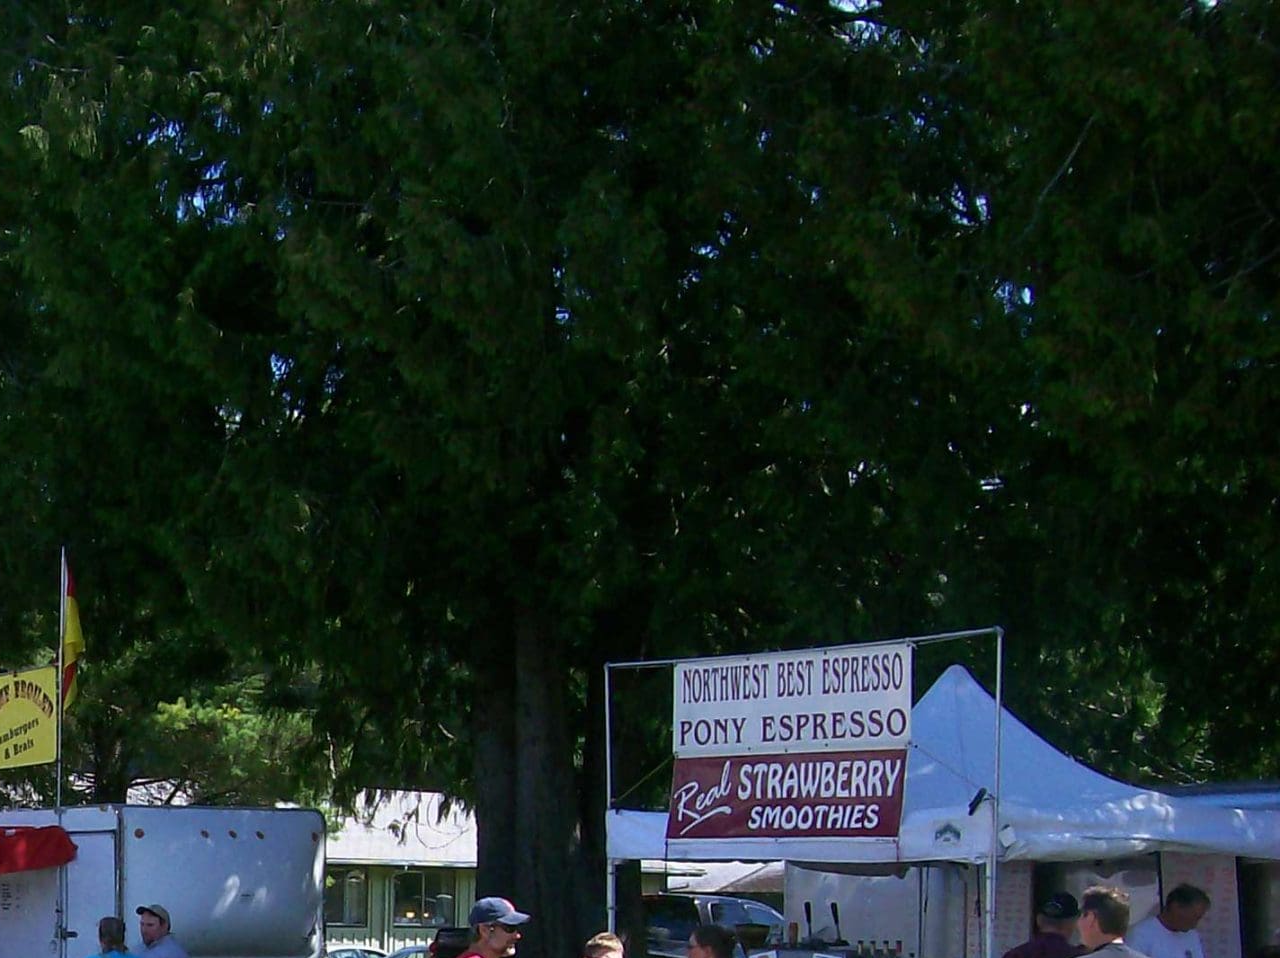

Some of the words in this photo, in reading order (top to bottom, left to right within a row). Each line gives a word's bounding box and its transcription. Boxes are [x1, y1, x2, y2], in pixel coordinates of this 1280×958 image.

[682, 663, 770, 704] NORTHWEST
[777, 660, 814, 698] BEST
[822, 652, 904, 695] ESPRESSO
[680, 717, 747, 746] PONY
[761, 708, 907, 743] ESPRESSO
[674, 760, 732, 823] Real
[738, 759, 902, 800] STRAWBERRY
[747, 804, 880, 830] SMOOTHIES
